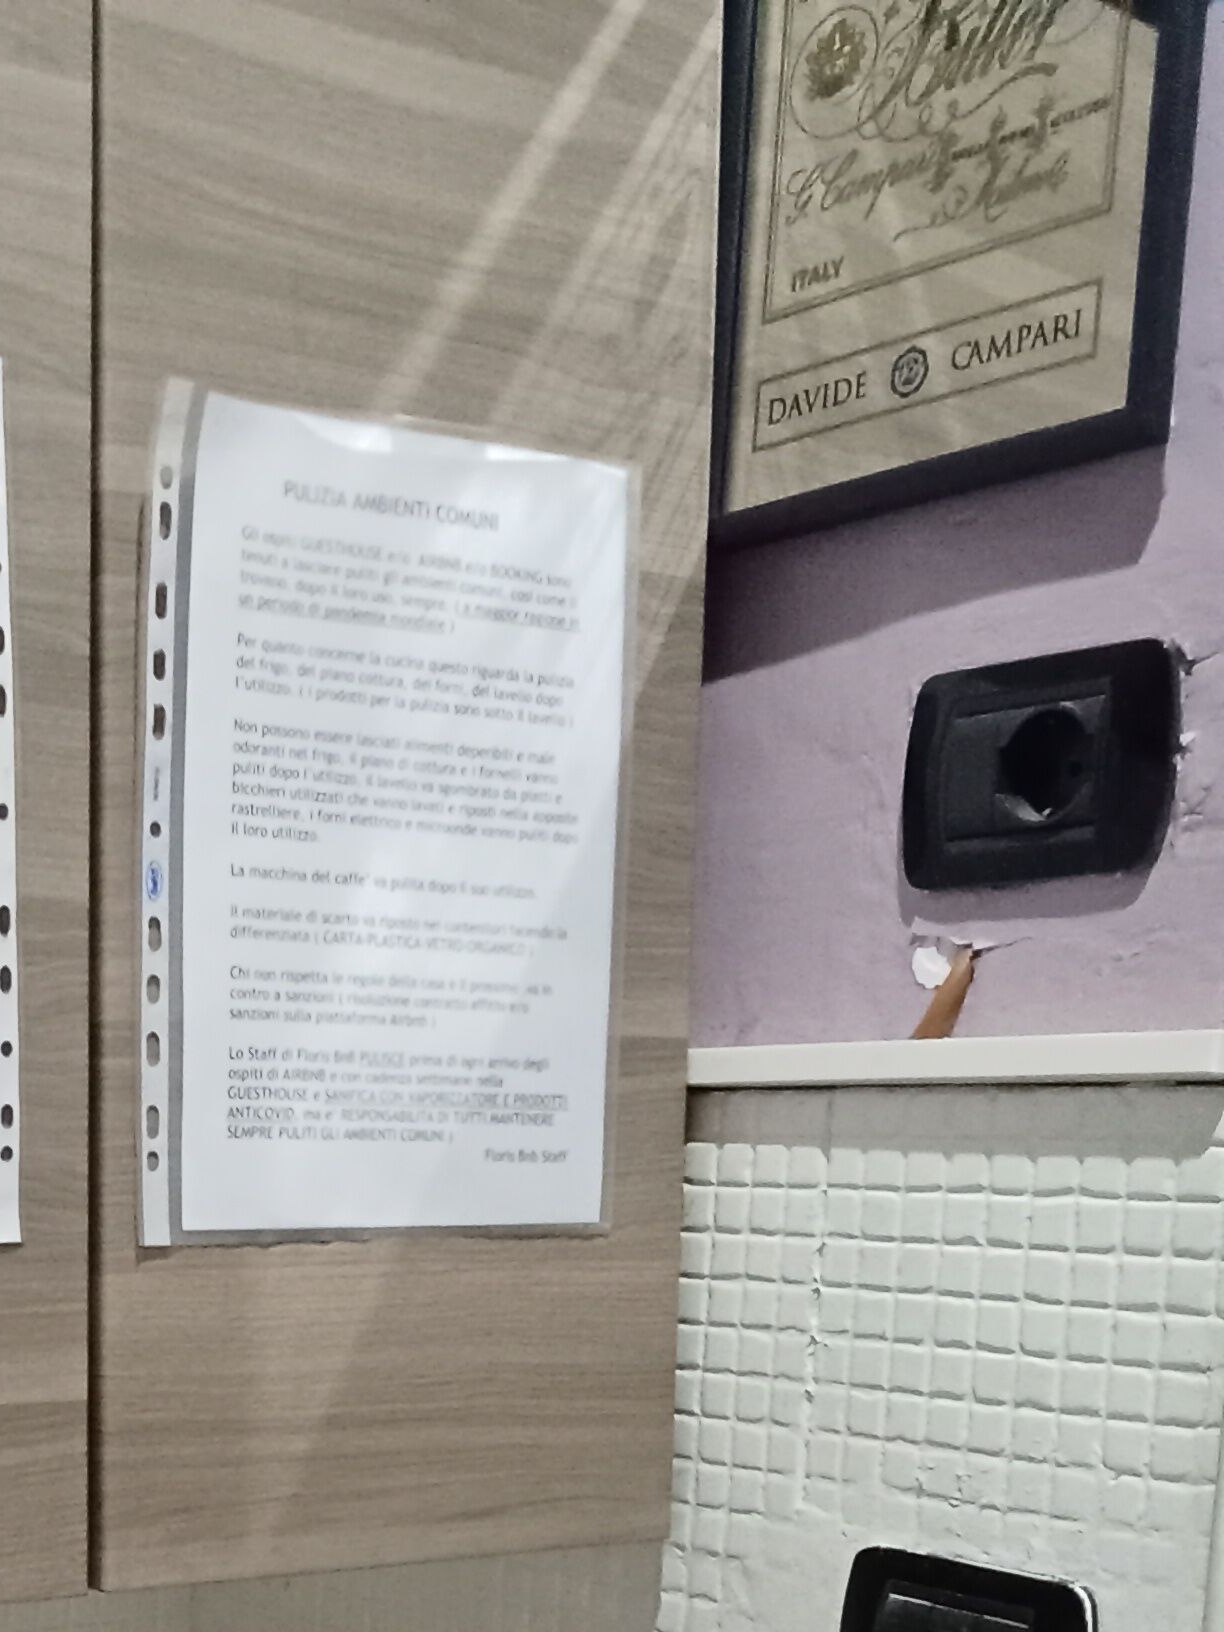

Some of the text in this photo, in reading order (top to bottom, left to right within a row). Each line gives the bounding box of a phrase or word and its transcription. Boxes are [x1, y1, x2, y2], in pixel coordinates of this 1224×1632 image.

[790, 256, 845, 293] ITALY
[767, 308, 1082, 425] DAVIDE CAMPARI
[282, 480, 347, 507] PULIZIA
[235, 634, 257, 650] Per
[233, 720, 258, 736] Non
[232, 763, 300, 786] puliti dopo
[231, 781, 285, 801] bicchieri
[316, 810, 347, 827] forni
[231, 822, 238, 837] Il
[243, 824, 268, 840] loro
[231, 864, 245, 878] La
[249, 868, 306, 884] macchina
[312, 871, 330, 886] del
[231, 966, 247, 980] Chi
[228, 1046, 277, 1061] Lo Staff
[227, 1067, 263, 1085] ospiti
[226, 1085, 308, 1102] GUESTHOUSE
[226, 1124, 273, 1140] SEMPRE
[484, 1147, 514, 1161] Floris
[541, 1148, 567, 1161] Staff
